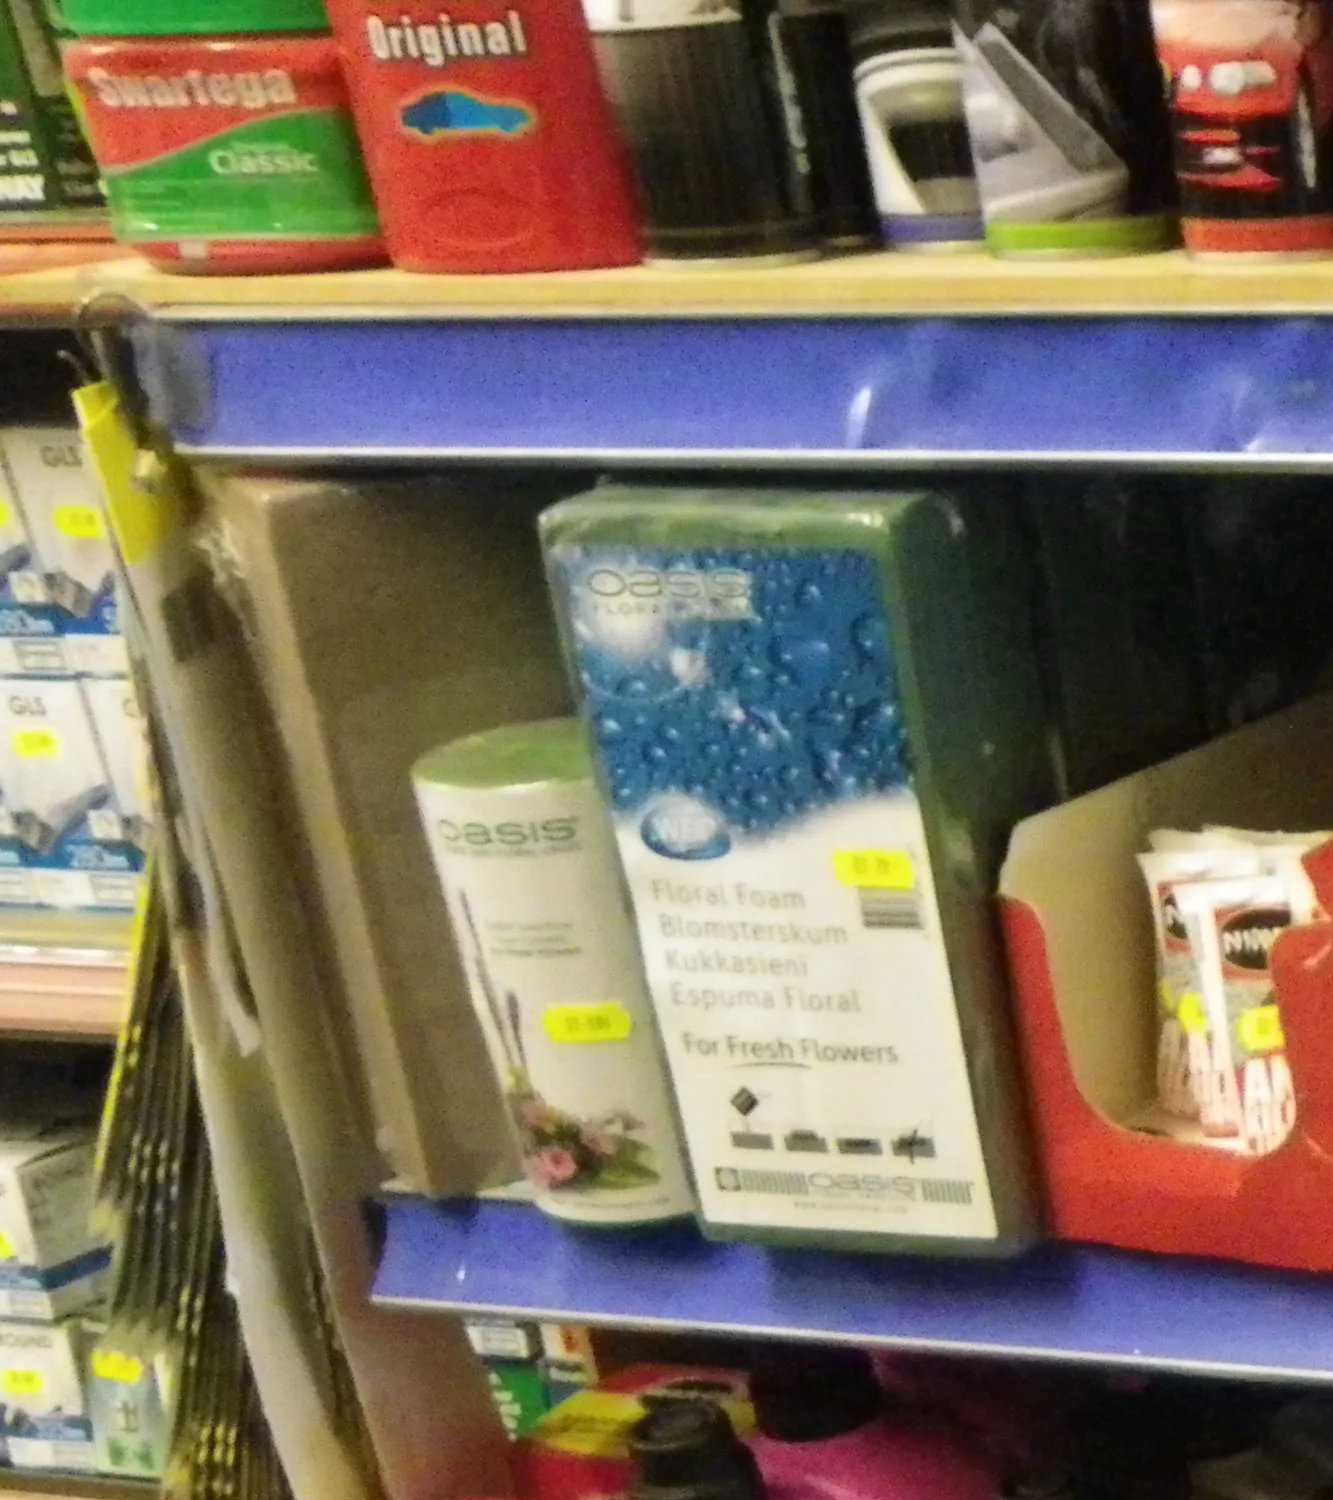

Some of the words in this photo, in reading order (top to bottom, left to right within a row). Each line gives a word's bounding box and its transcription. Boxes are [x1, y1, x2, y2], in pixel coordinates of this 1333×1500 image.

[367, 12, 527, 66] Original
[209, 148, 320, 177] Classic
[649, 879, 729, 907] Floral
[734, 882, 806, 911] Foam
[781, 986, 861, 1015] Floral
[681, 1031, 720, 1057] For
[725, 1032, 794, 1060] Fresh
[800, 1037, 900, 1065] Flowers
